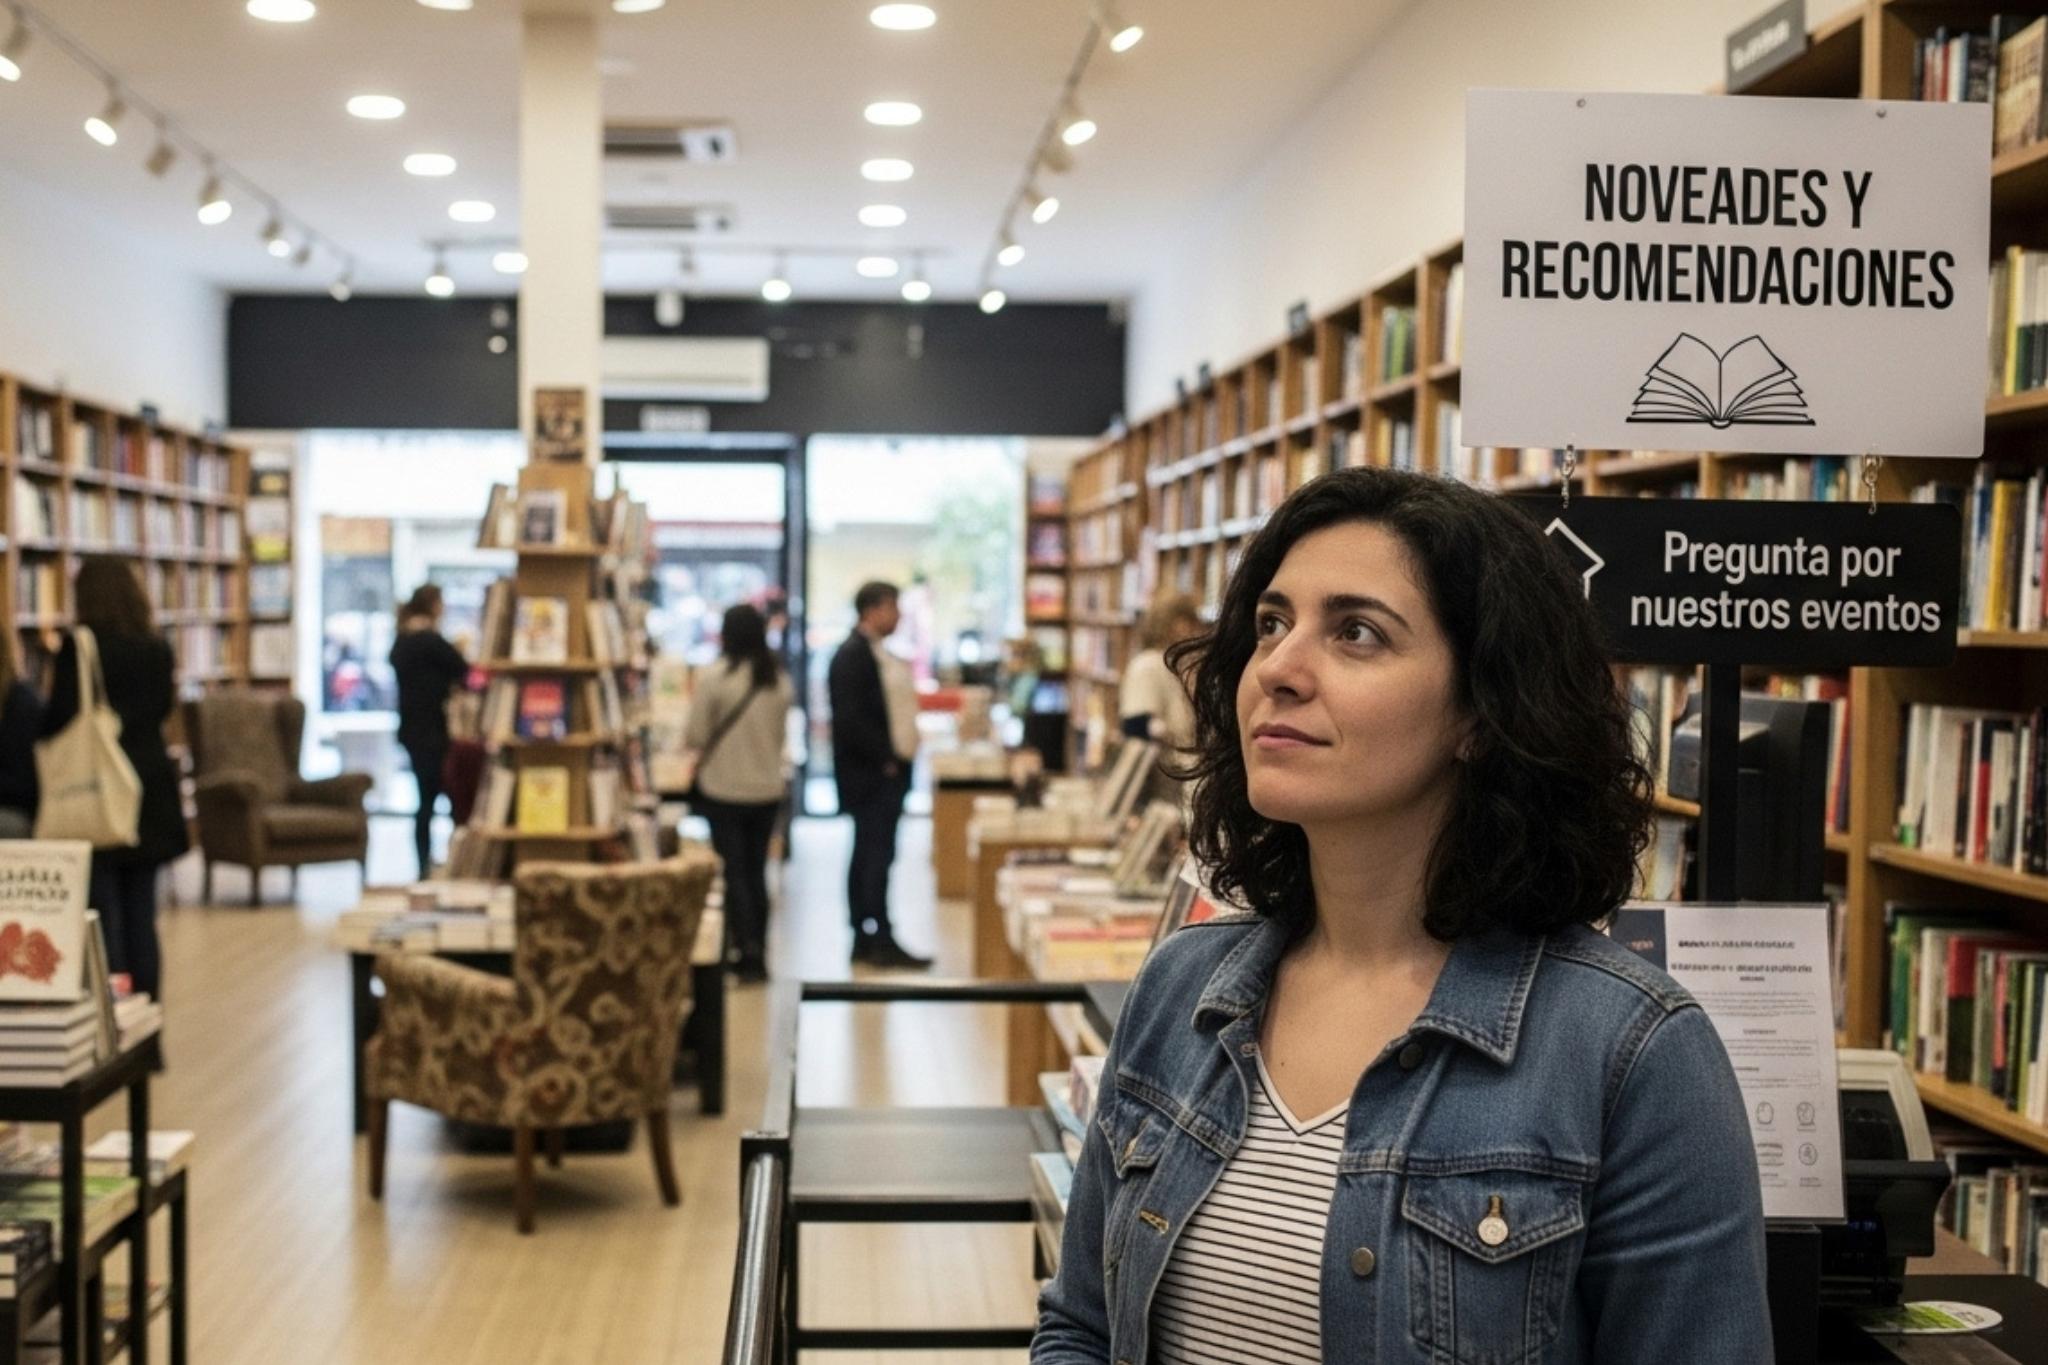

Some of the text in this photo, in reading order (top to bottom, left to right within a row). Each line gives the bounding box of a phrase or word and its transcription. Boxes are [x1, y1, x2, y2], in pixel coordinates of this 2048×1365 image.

[1584, 163, 1873, 229] NOVEADES Y
[1501, 239, 1955, 310] RECOMENDACIONES
[1664, 530, 1901, 587] Pregunta por
[1630, 591, 1941, 633] nuestros eventos
